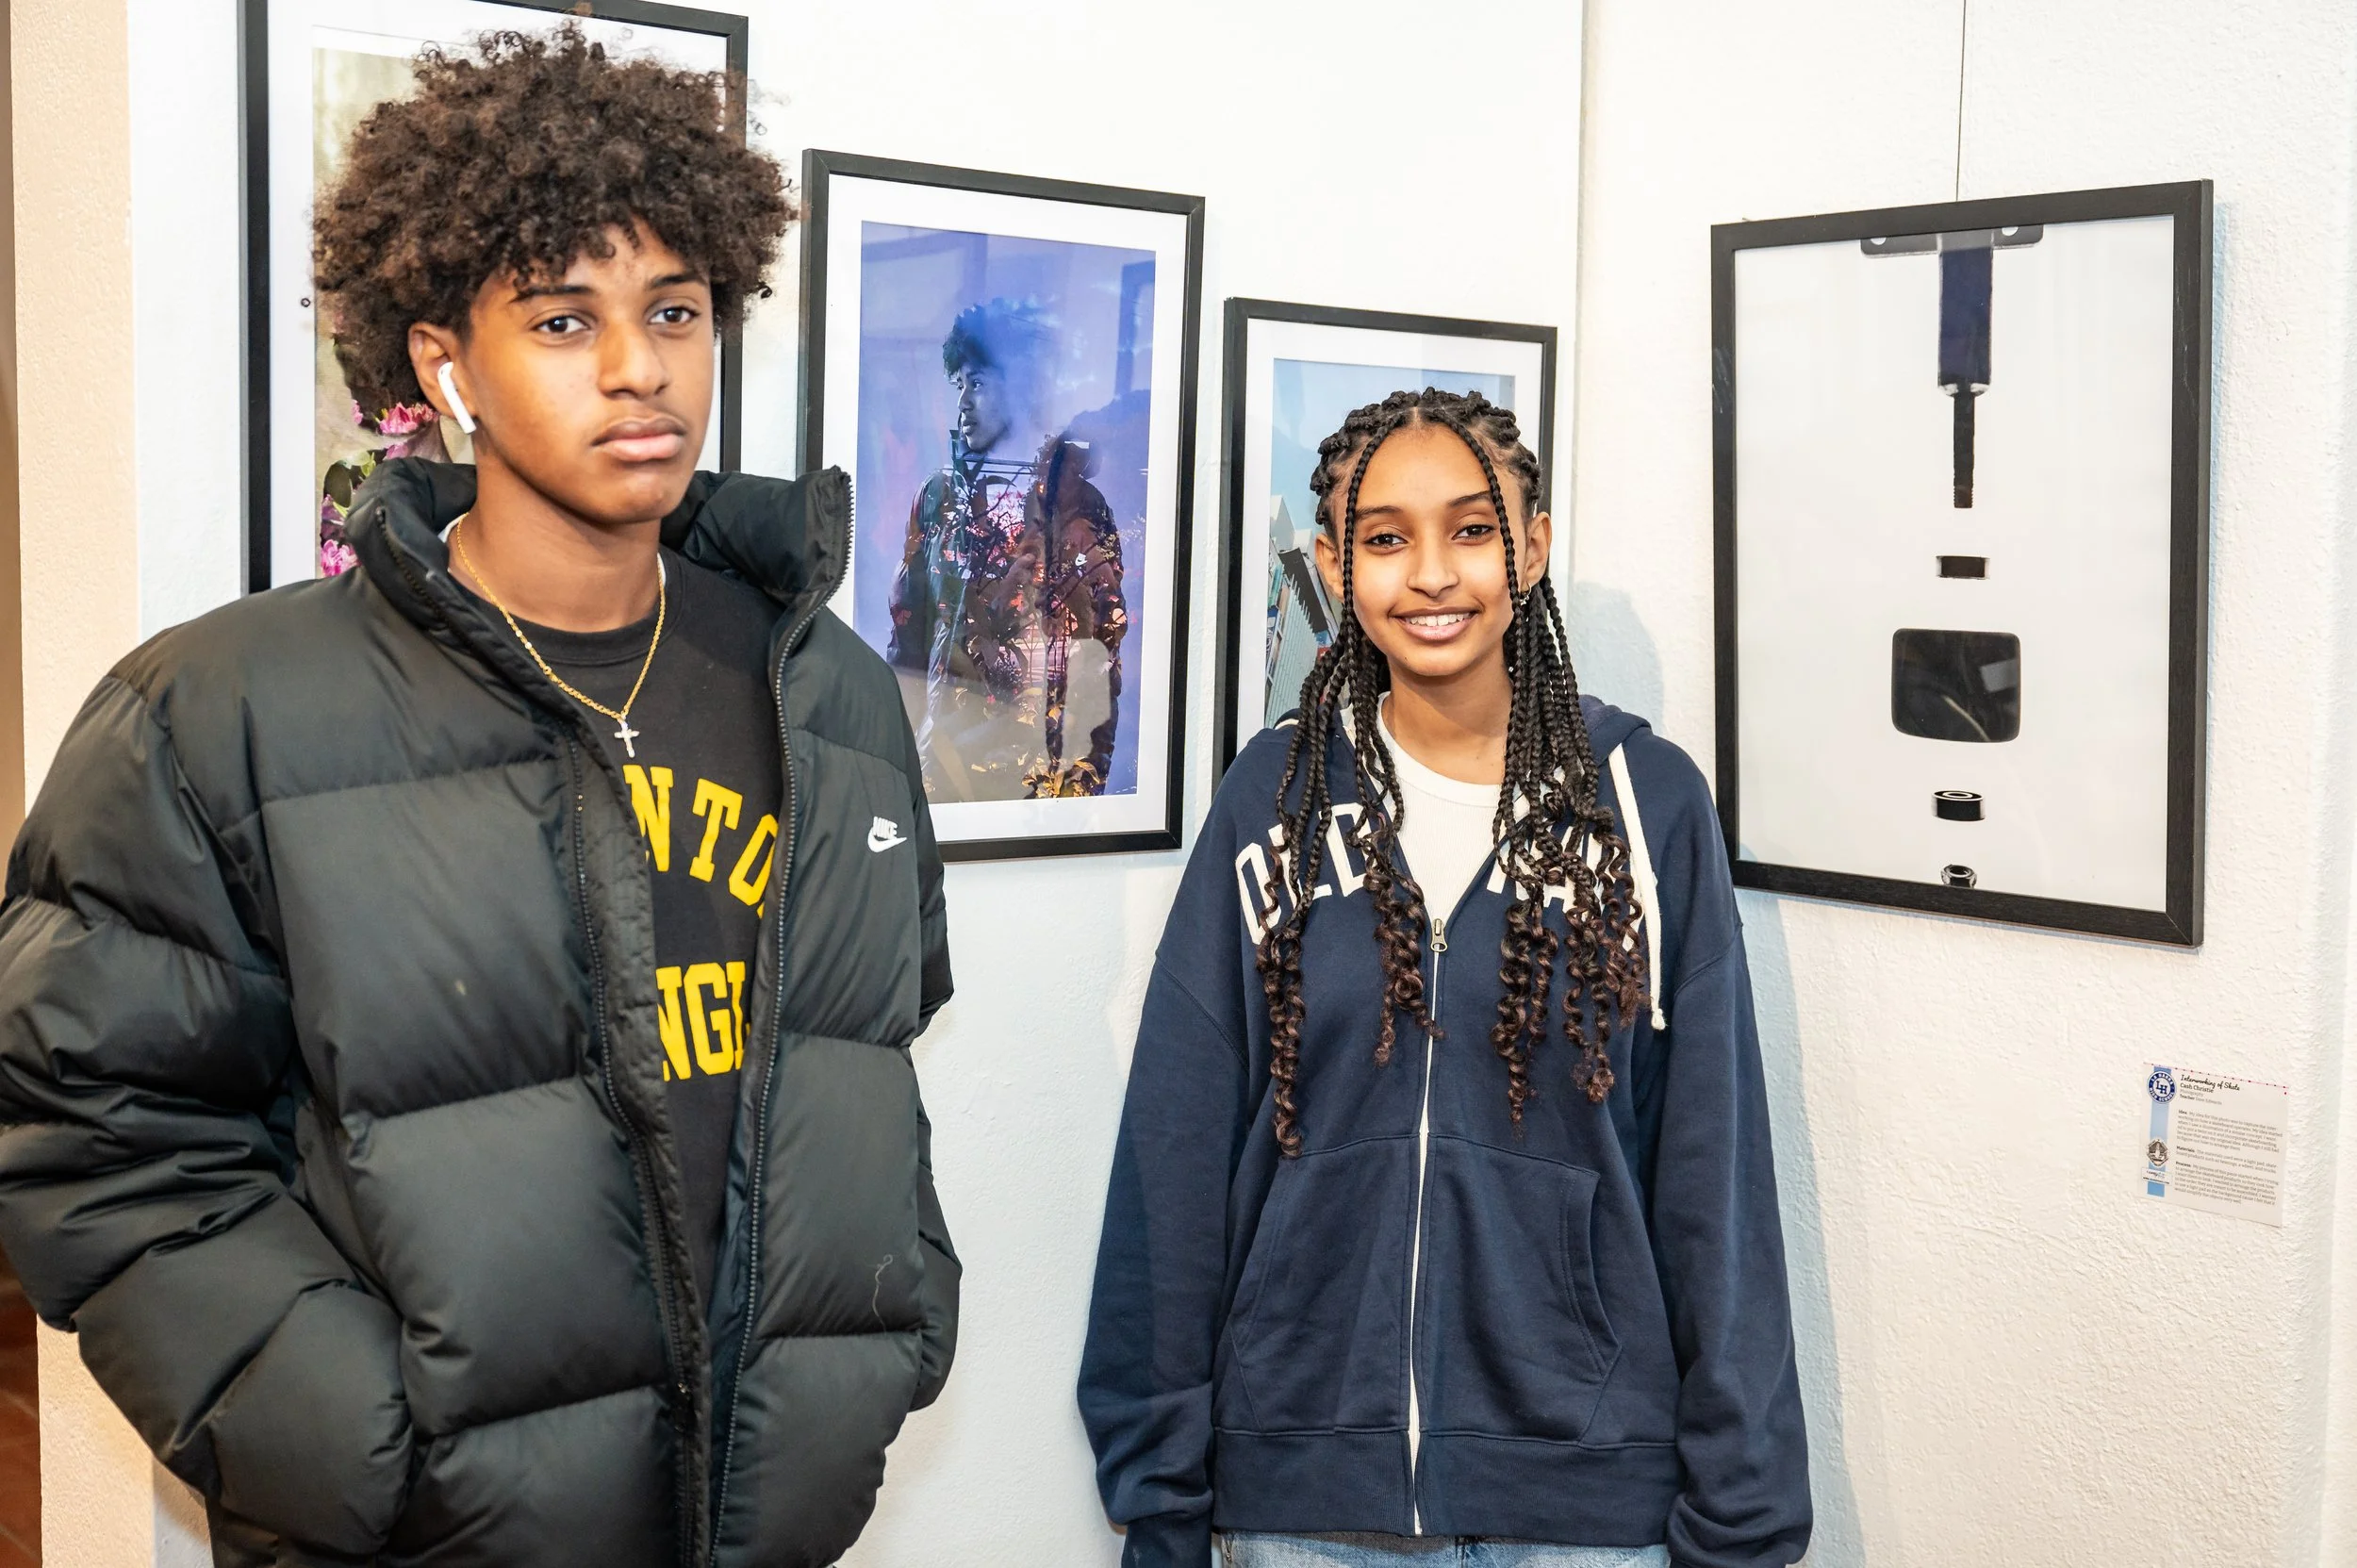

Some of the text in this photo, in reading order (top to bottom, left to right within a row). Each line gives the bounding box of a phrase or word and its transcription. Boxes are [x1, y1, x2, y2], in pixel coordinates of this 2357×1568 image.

[623, 765, 779, 918] NTO
[2180, 1074, 2216, 1090] Interworking
[2217, 1080, 2224, 1090] of
[2194, 1085, 2214, 1093] Christie
